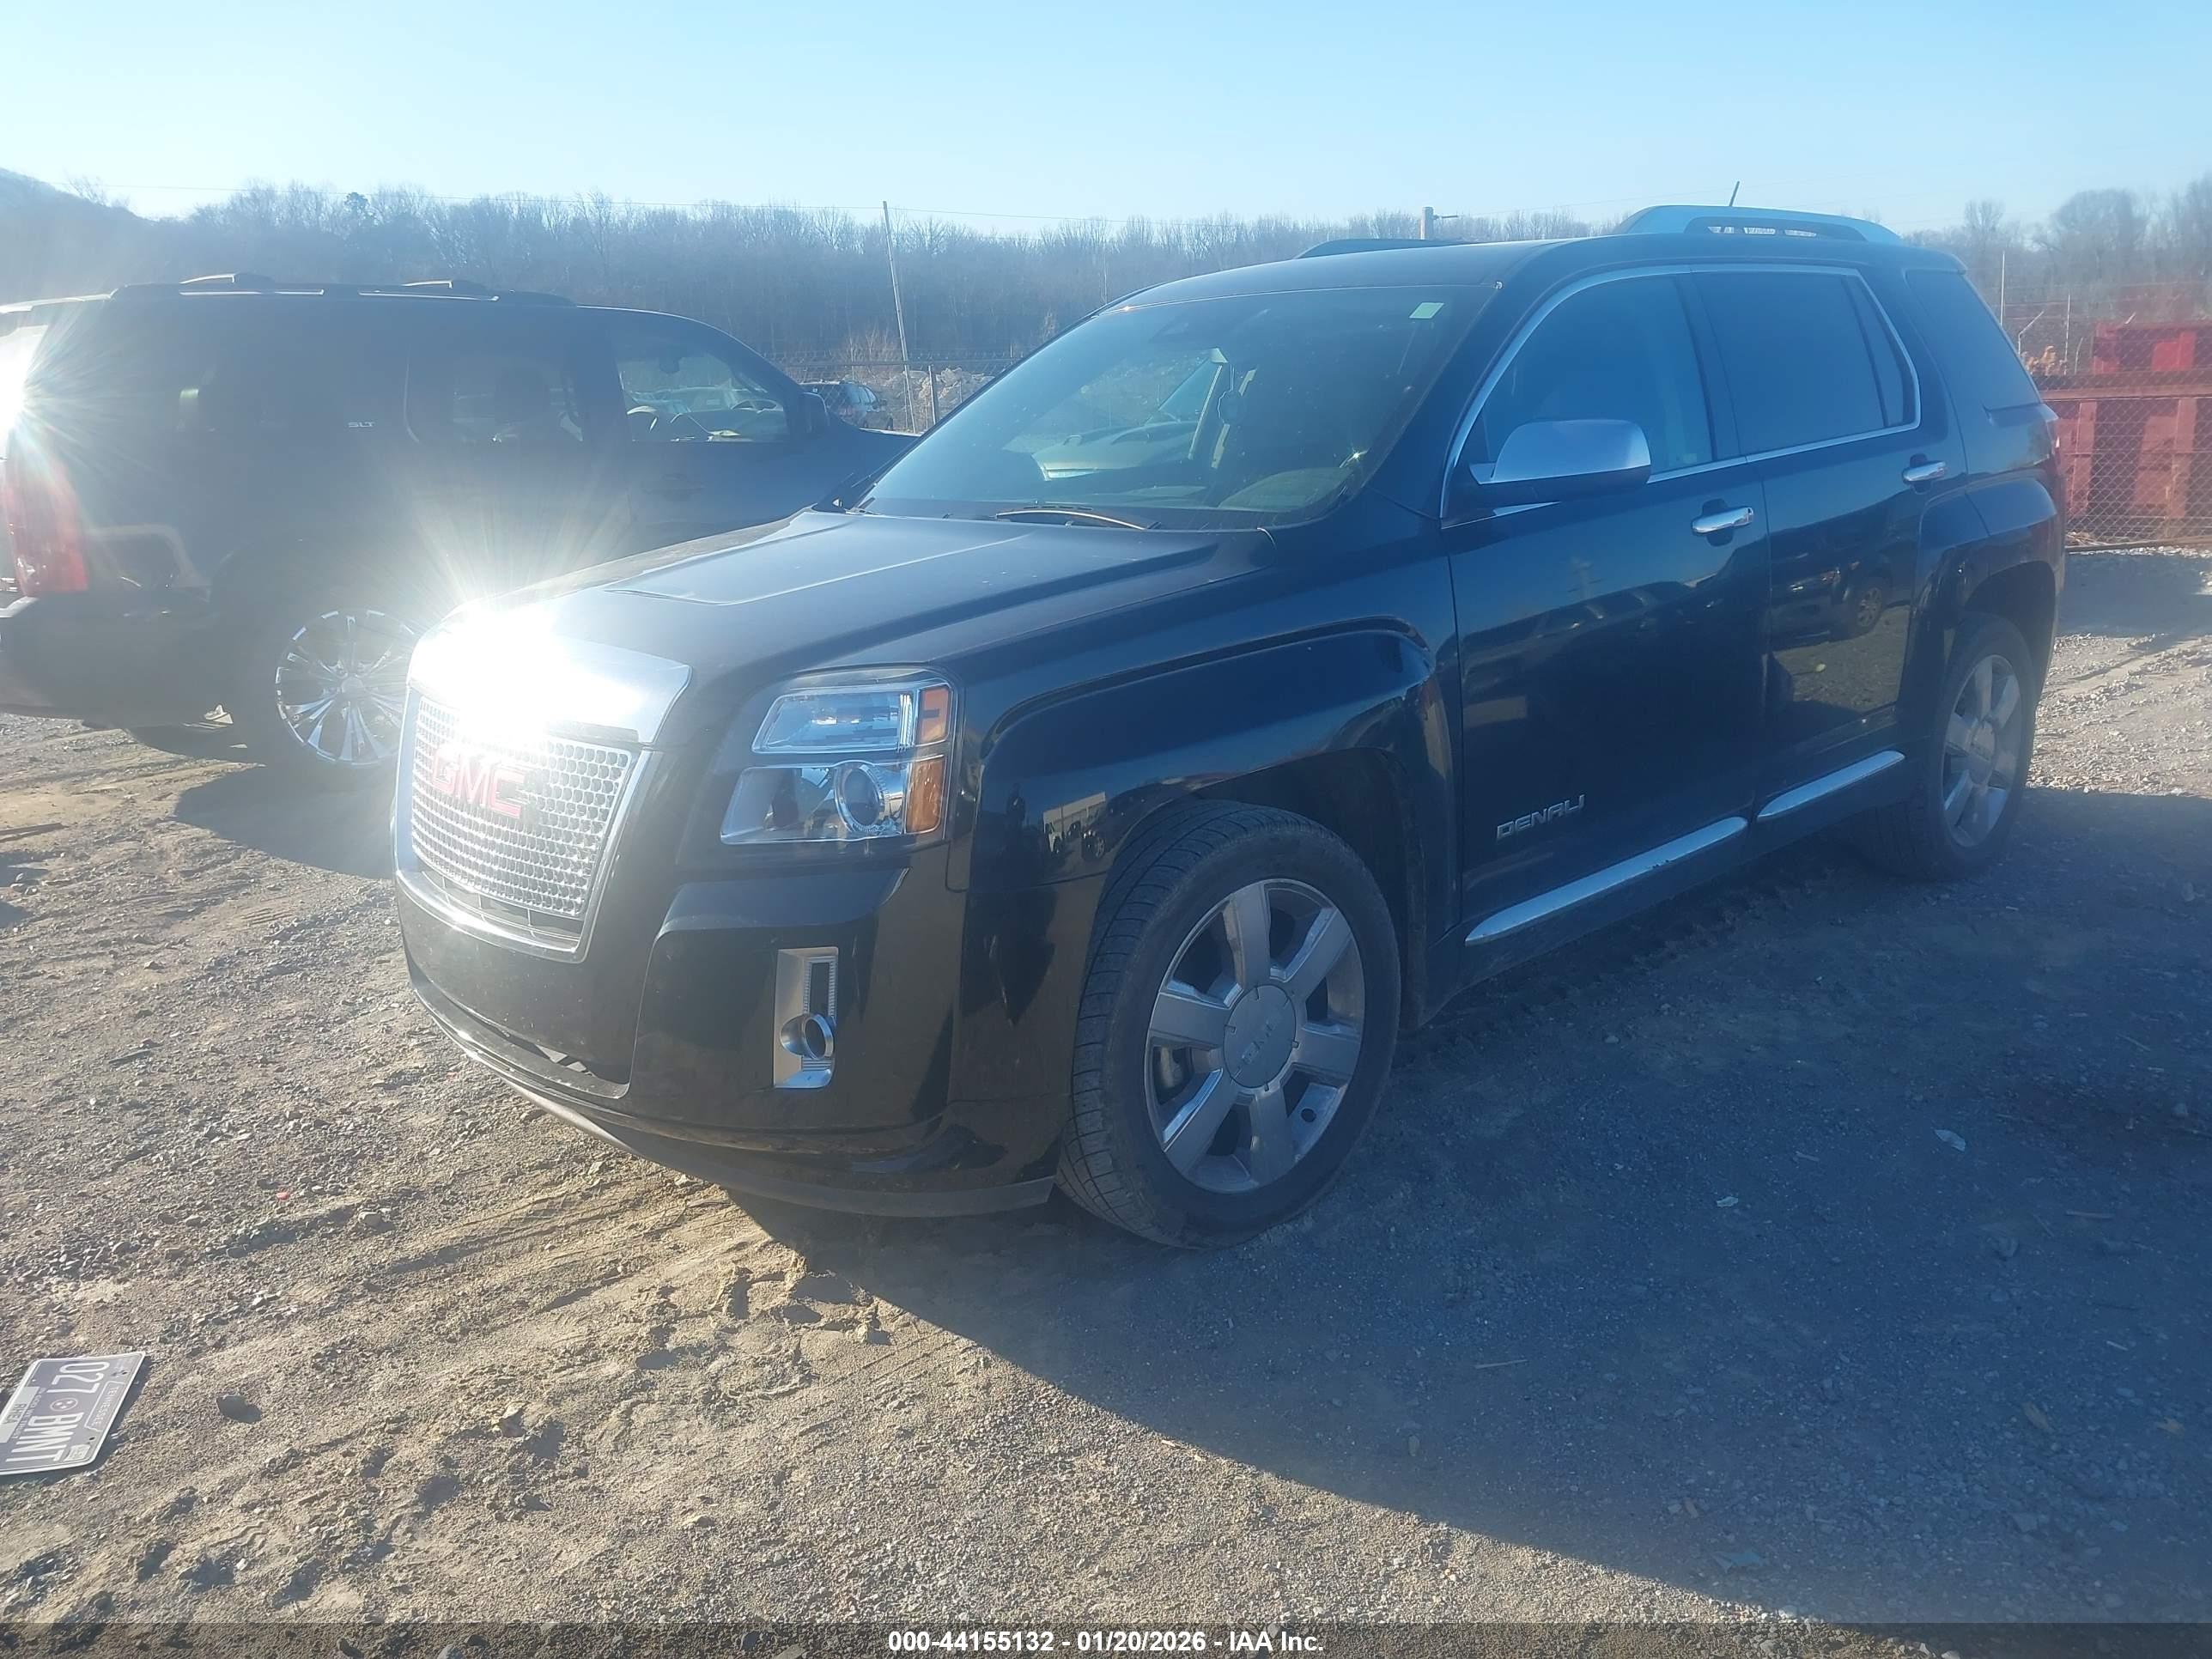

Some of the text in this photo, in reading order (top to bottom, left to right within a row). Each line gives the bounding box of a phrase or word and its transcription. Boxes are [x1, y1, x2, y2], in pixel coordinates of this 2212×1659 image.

[431, 747, 526, 819] GMC
[1496, 793, 1586, 841] DENALI
[5, 1361, 110, 1462] 027 BMNT
[92, 1385, 119, 1426] TENNESSEE
